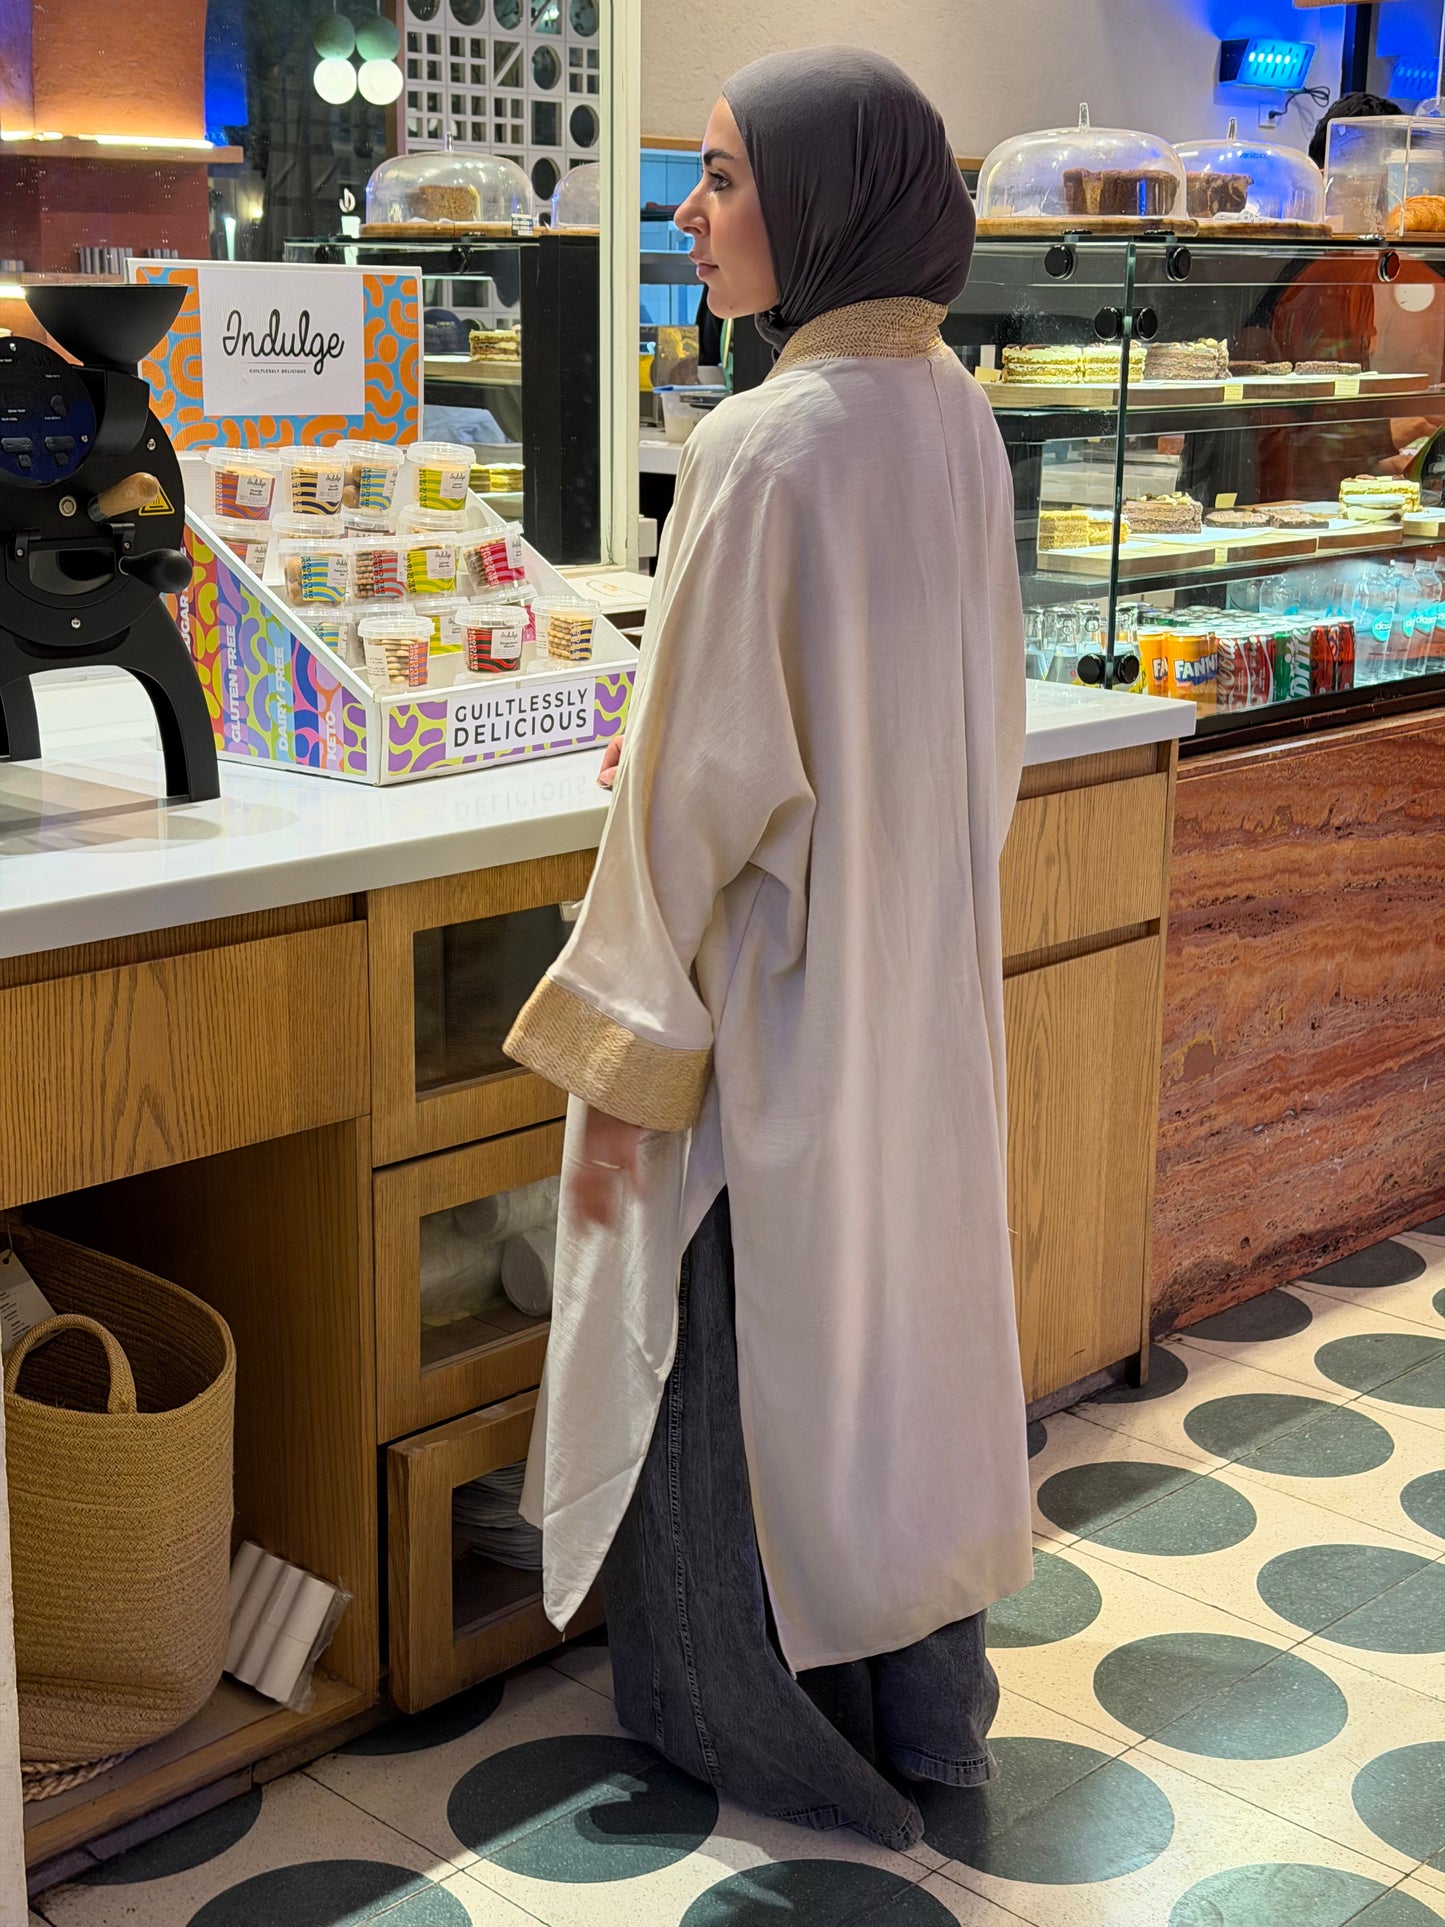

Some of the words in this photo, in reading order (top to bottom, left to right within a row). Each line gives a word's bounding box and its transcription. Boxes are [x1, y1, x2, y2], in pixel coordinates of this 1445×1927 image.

[222, 308, 345, 376] Indulge
[306, 556, 314, 599] DELICIOUS
[378, 554, 386, 595] DELICIOUS
[226, 624, 237, 670] FREE
[274, 646, 286, 693] FREE
[229, 673, 241, 744] GLUTEN
[277, 694, 288, 751] DAIRY
[454, 708, 587, 748] DELICIOUS
[455, 688, 589, 723] GUILTLESSLY
[325, 710, 337, 760] KETO
